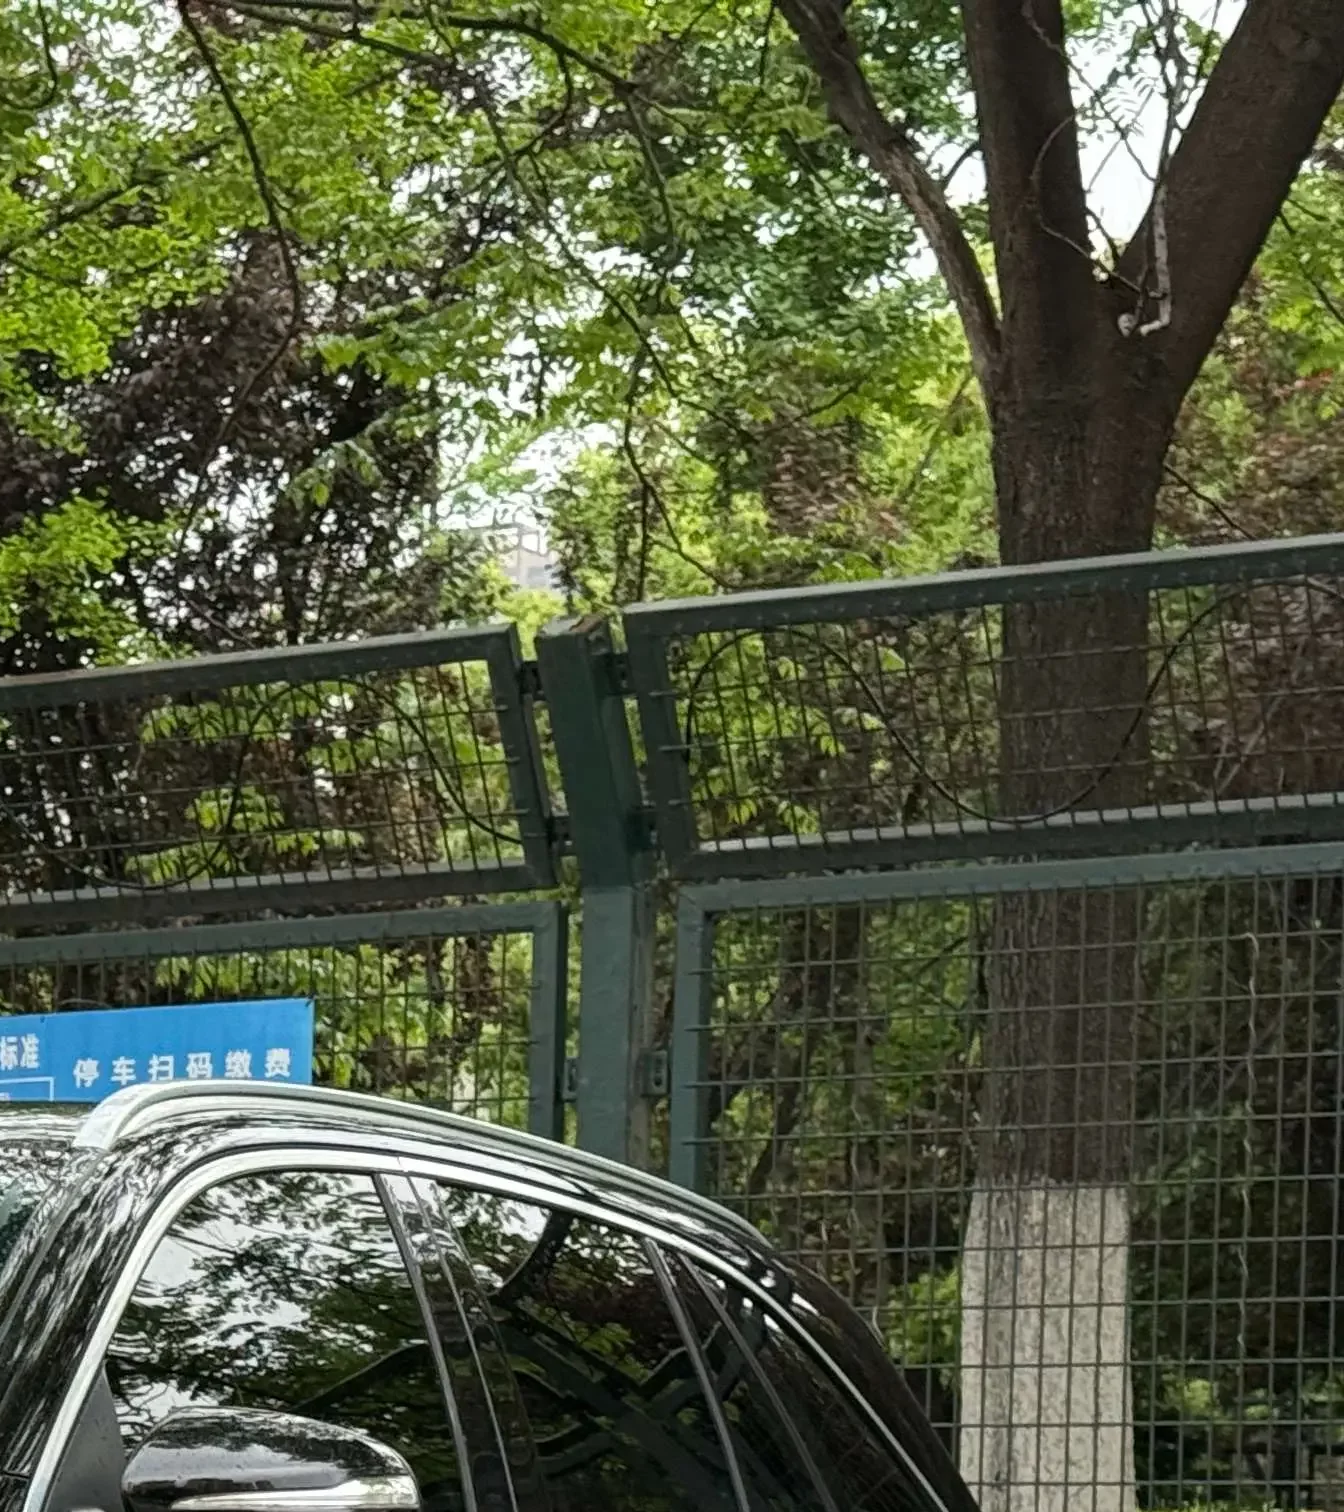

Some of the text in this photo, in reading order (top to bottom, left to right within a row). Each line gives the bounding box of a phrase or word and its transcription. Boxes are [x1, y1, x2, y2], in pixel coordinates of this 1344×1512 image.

[73, 1047, 291, 1089] 停车扫码缴费
